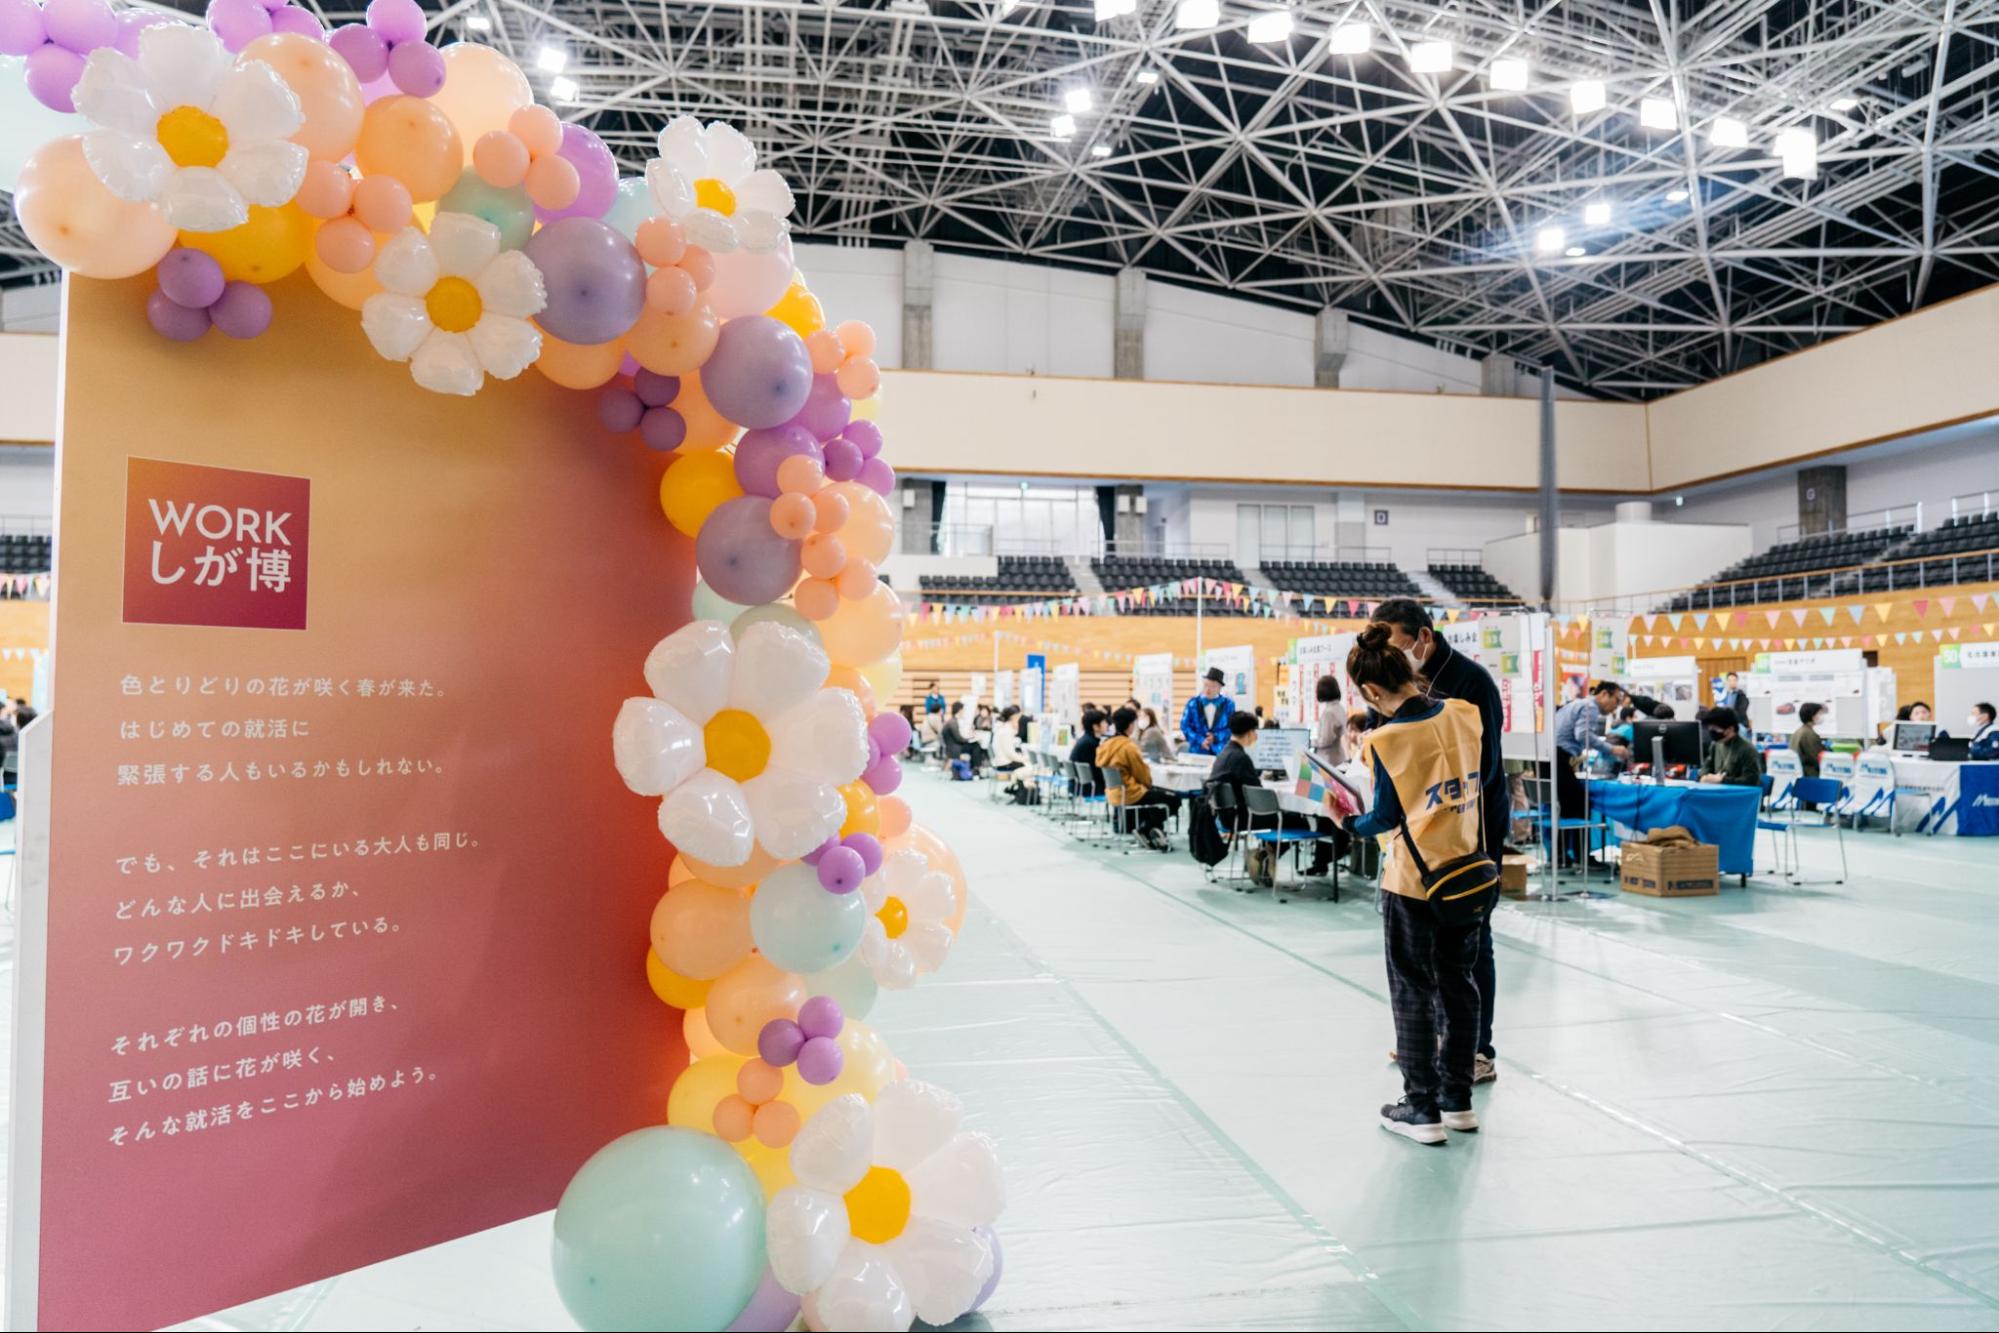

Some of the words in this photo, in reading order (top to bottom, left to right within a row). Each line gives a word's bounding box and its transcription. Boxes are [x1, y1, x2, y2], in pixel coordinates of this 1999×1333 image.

[148, 498, 293, 547] WORK
[150, 540, 292, 594] しが博
[120, 673, 445, 698] 色とりどりの花が咲く春が来た。
[120, 718, 310, 740] はじめての就活に
[117, 757, 445, 786] 緊張する人もいるかもしれない。
[116, 831, 480, 876] でも、それはここにいる大人も同じ。
[115, 880, 361, 921] どんな人に出会えるか、
[113, 917, 401, 967] ワクワクドキドキしている。
[110, 994, 399, 1057] それぞれの個性の花が開き、
[107, 1045, 336, 1104] 互いの話に花が咲く、
[108, 1066, 438, 1147] そんな就活をここから始めよう。
